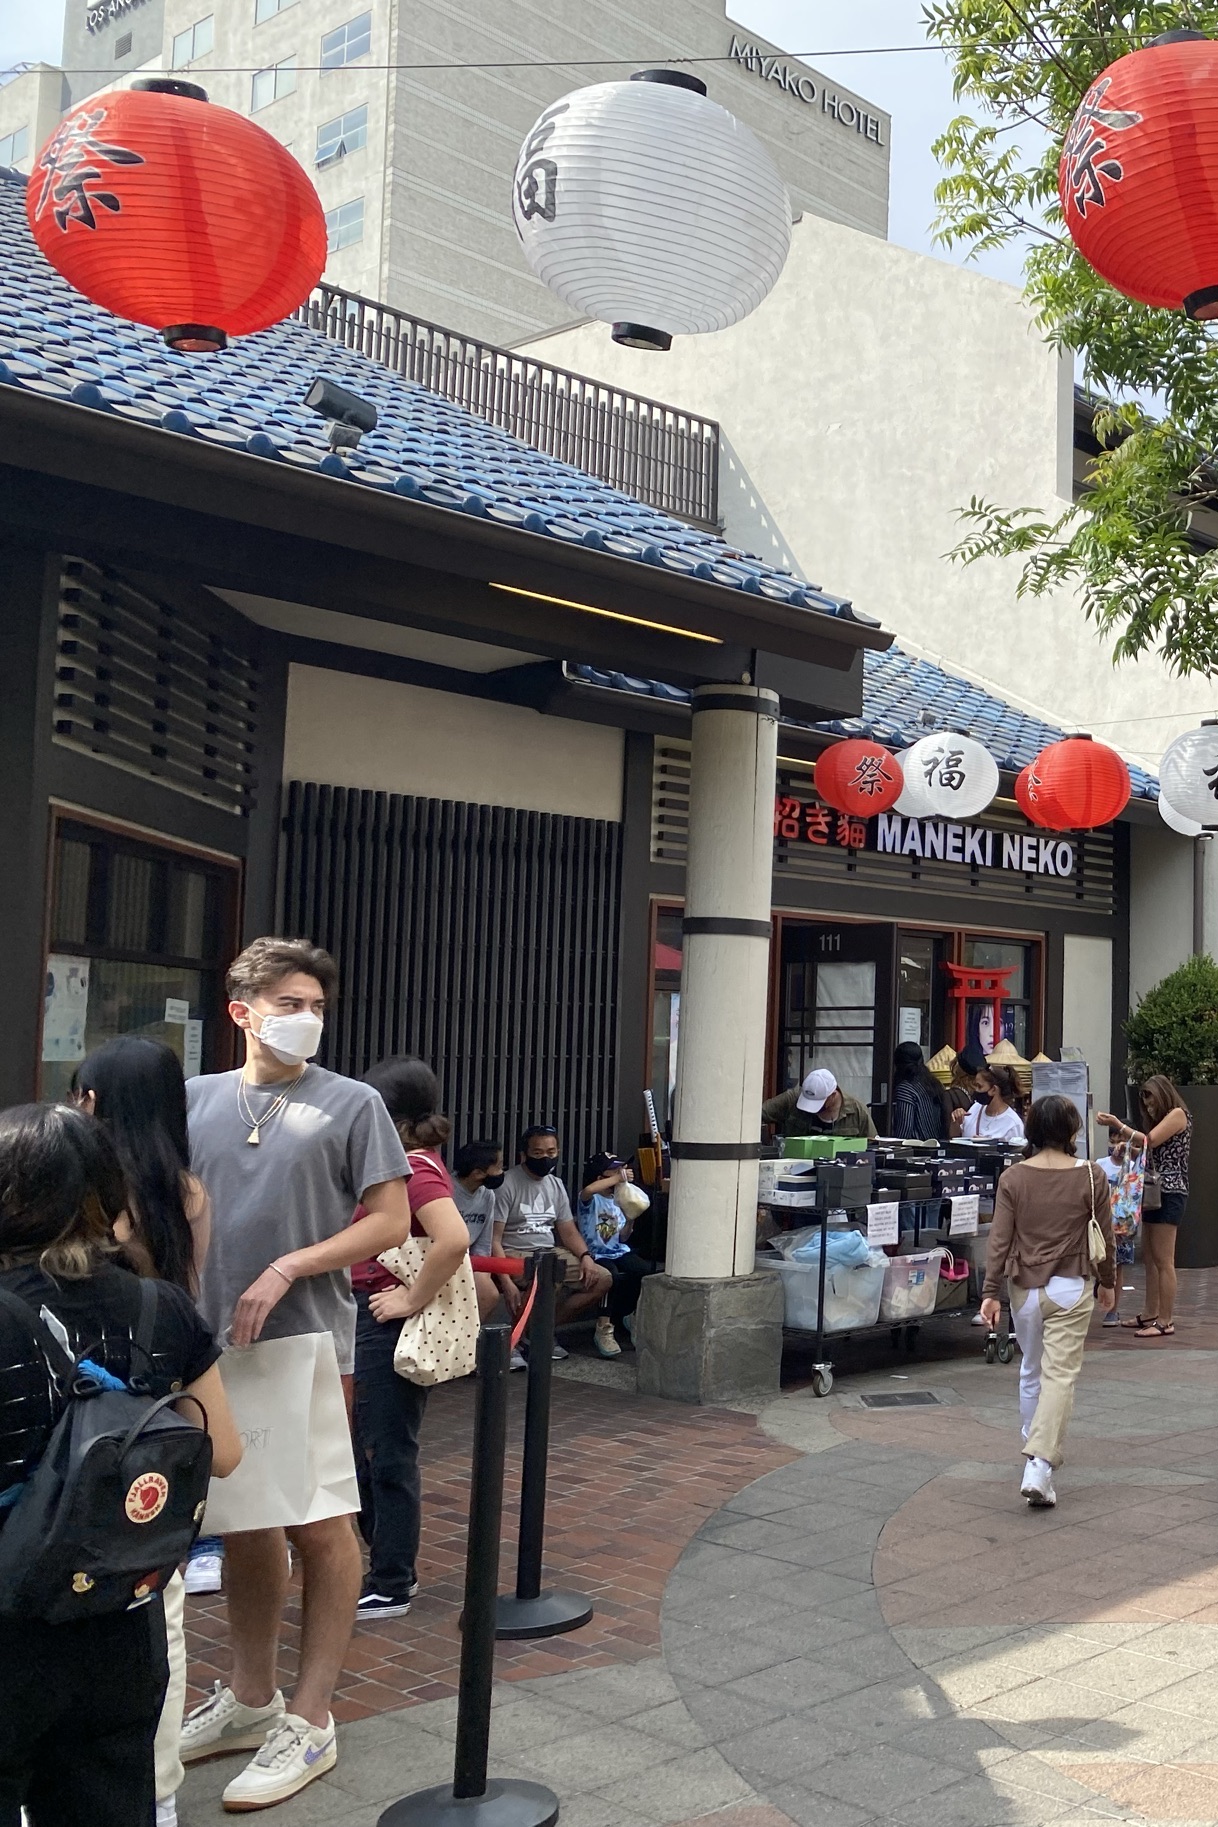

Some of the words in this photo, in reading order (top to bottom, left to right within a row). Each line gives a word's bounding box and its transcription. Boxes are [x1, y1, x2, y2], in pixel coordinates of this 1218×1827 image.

[729, 34, 818, 103] MIYAKO
[823, 89, 885, 146] HOTEL
[35, 108, 146, 234] 祭
[1064, 77, 1143, 219] 祭
[849, 755, 893, 797] 祭
[921, 746, 966, 791] 福
[876, 813, 993, 867] MANEKI
[1002, 832, 1073, 877] NEKO
[819, 933, 841, 951] 111
